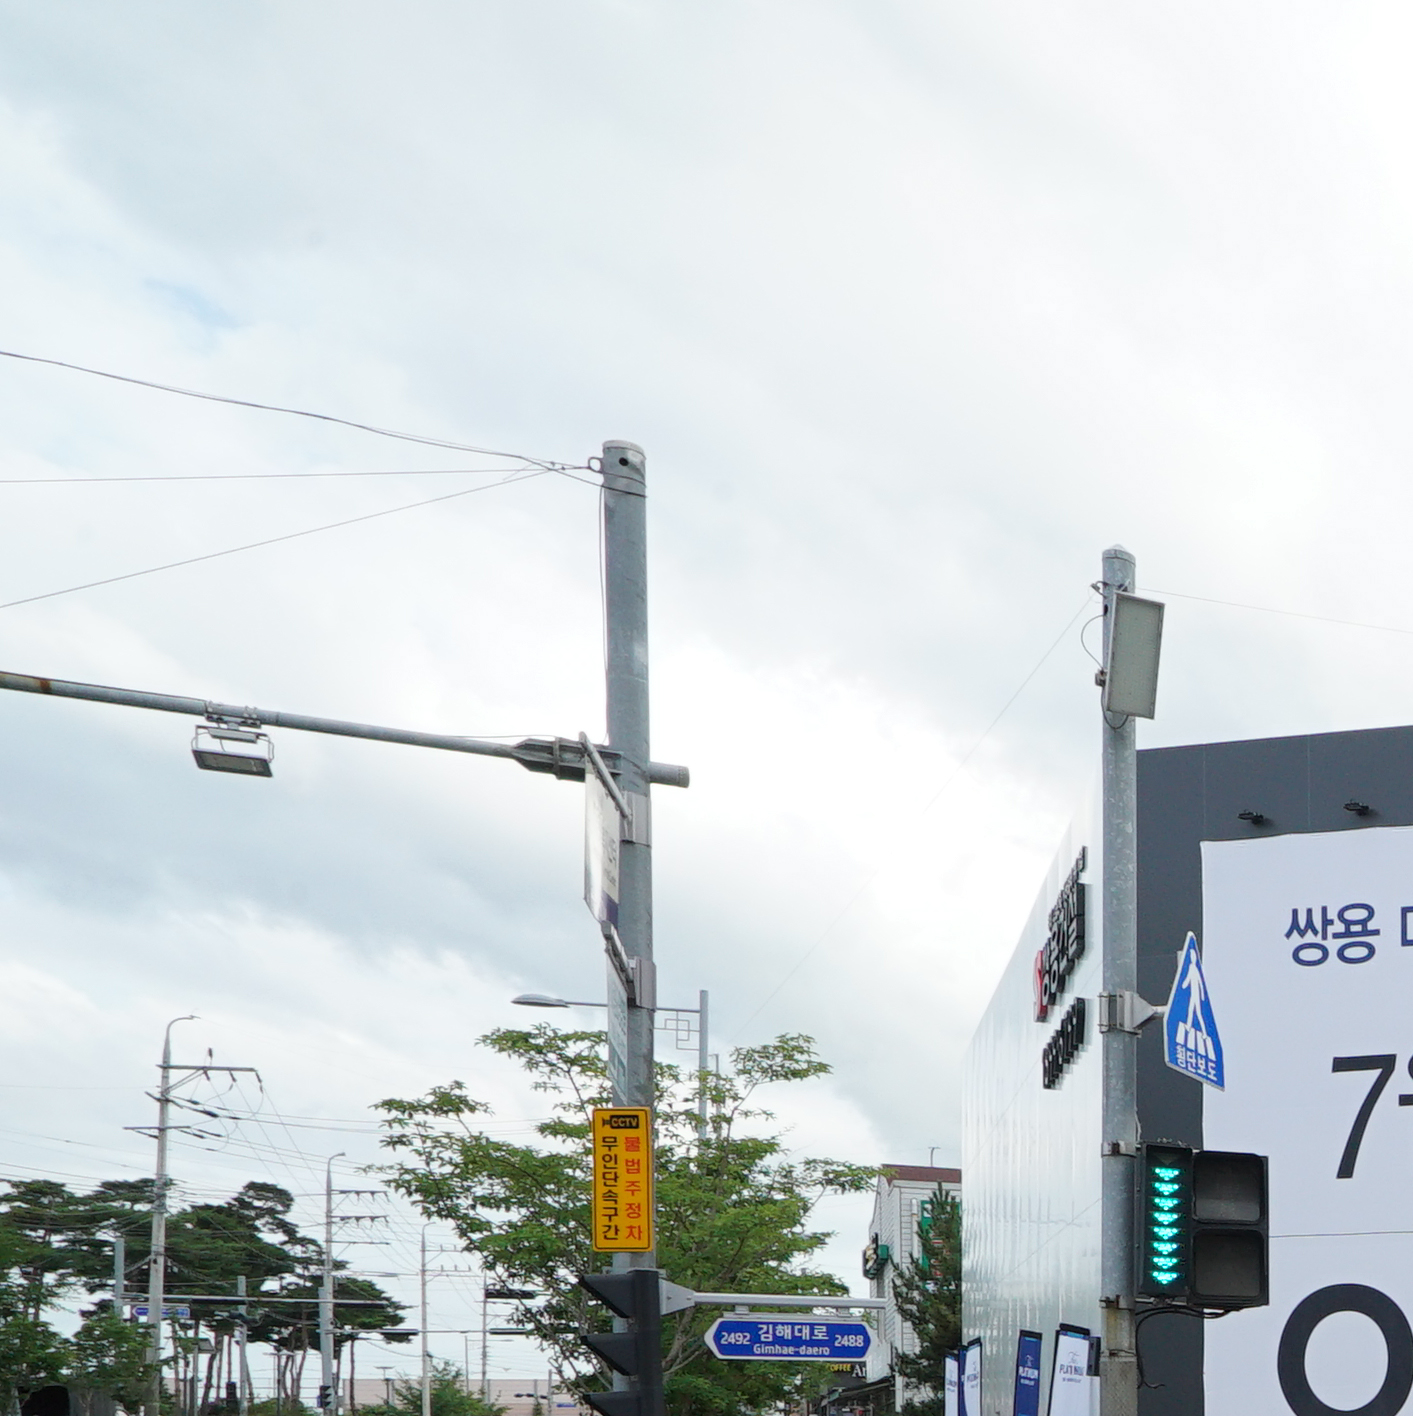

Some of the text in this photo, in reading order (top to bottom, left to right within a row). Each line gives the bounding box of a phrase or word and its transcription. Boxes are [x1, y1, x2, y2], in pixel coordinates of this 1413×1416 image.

[1283, 902, 1381, 967] 쌍용
[1175, 1044, 1218, 1082] 횡단보도
[611, 1117, 638, 1127] CCTV
[600, 1136, 620, 1241] 무인단속구간
[623, 1136, 642, 1241] 불법주정차
[720, 1324, 864, 1347] 2492 김해대로 2488
[753, 1343, 830, 1355] Gimhae-daero
